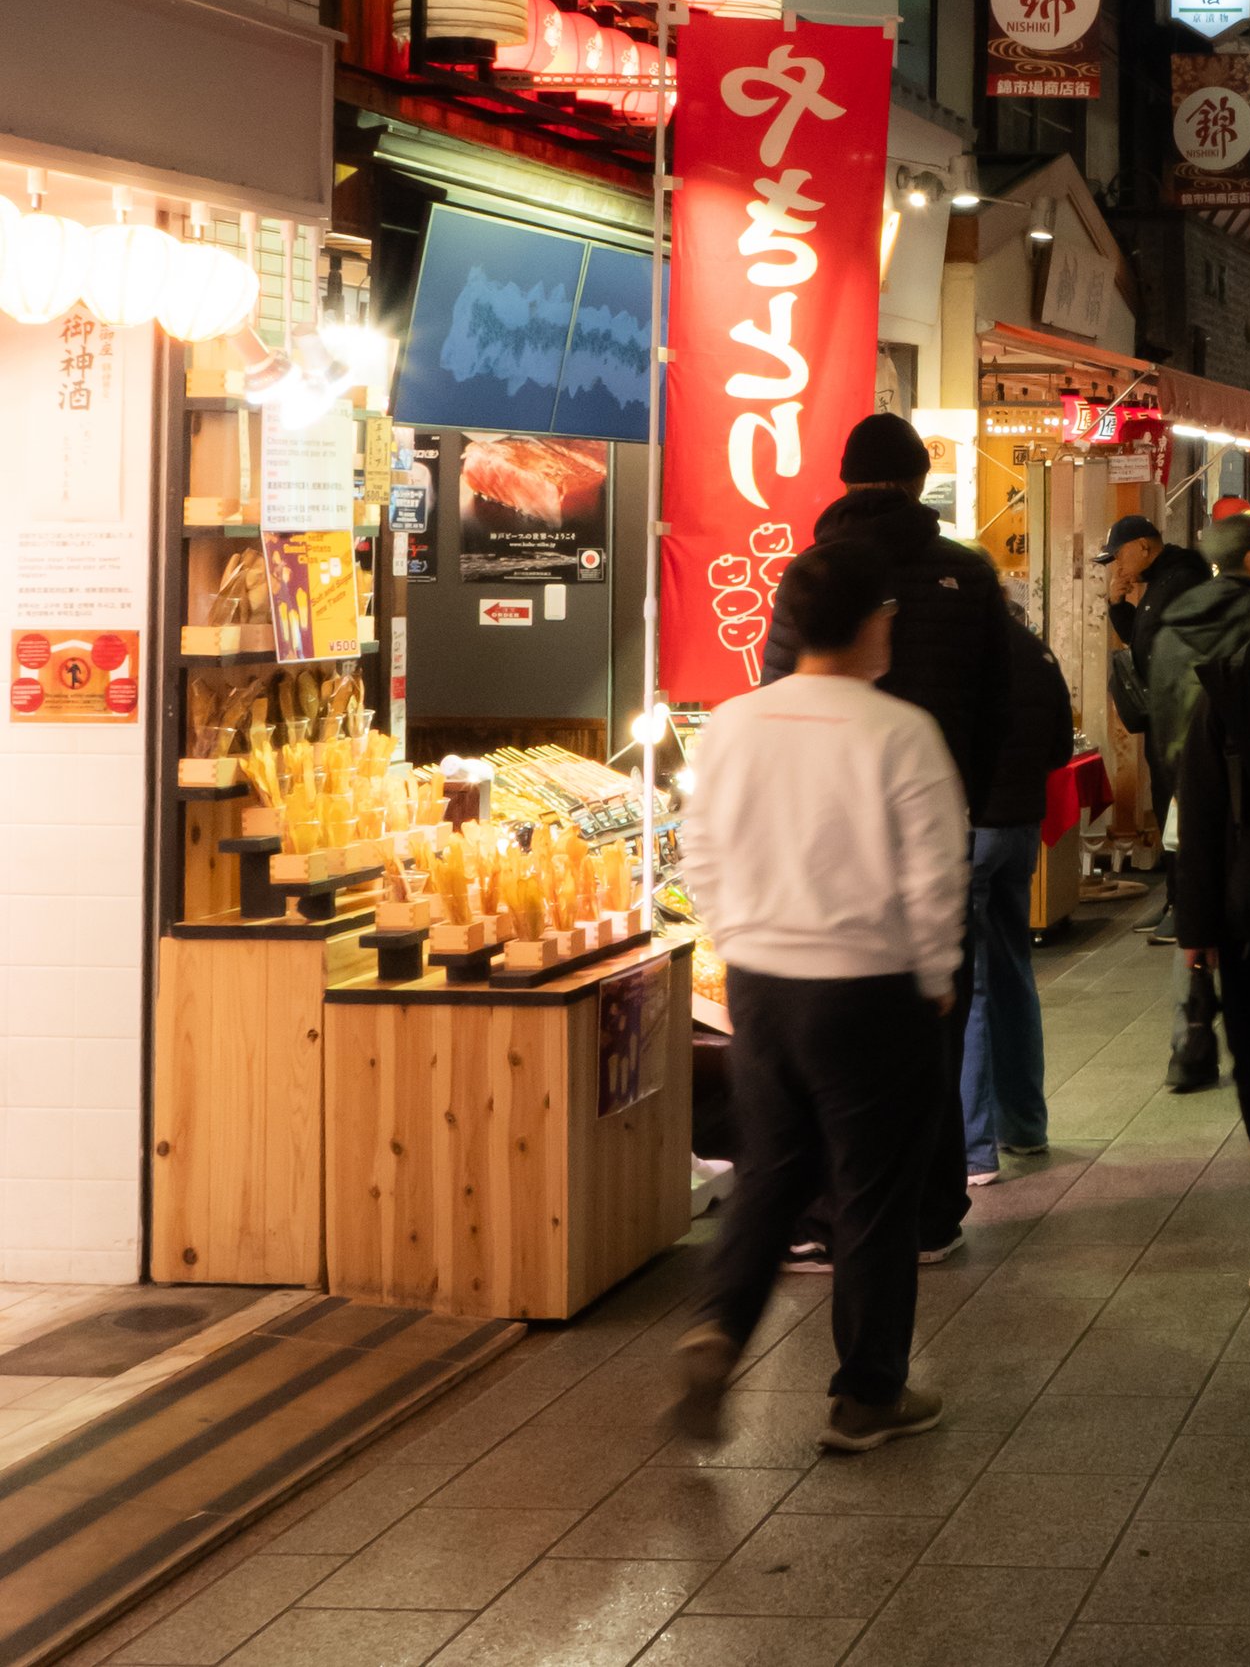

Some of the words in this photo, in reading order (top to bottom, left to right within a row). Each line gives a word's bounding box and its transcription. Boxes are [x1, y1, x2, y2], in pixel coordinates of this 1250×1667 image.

[1006, 21, 1050, 33] NISHIKI
[996, 79, 1090, 96] 錦市場商店街
[1185, 96, 1238, 159] 錦
[1186, 148, 1219, 159] NISHIKI
[720, 44, 847, 510] やきとり
[58, 313, 95, 411] 御神酒
[329, 639, 358, 652] ¥500
